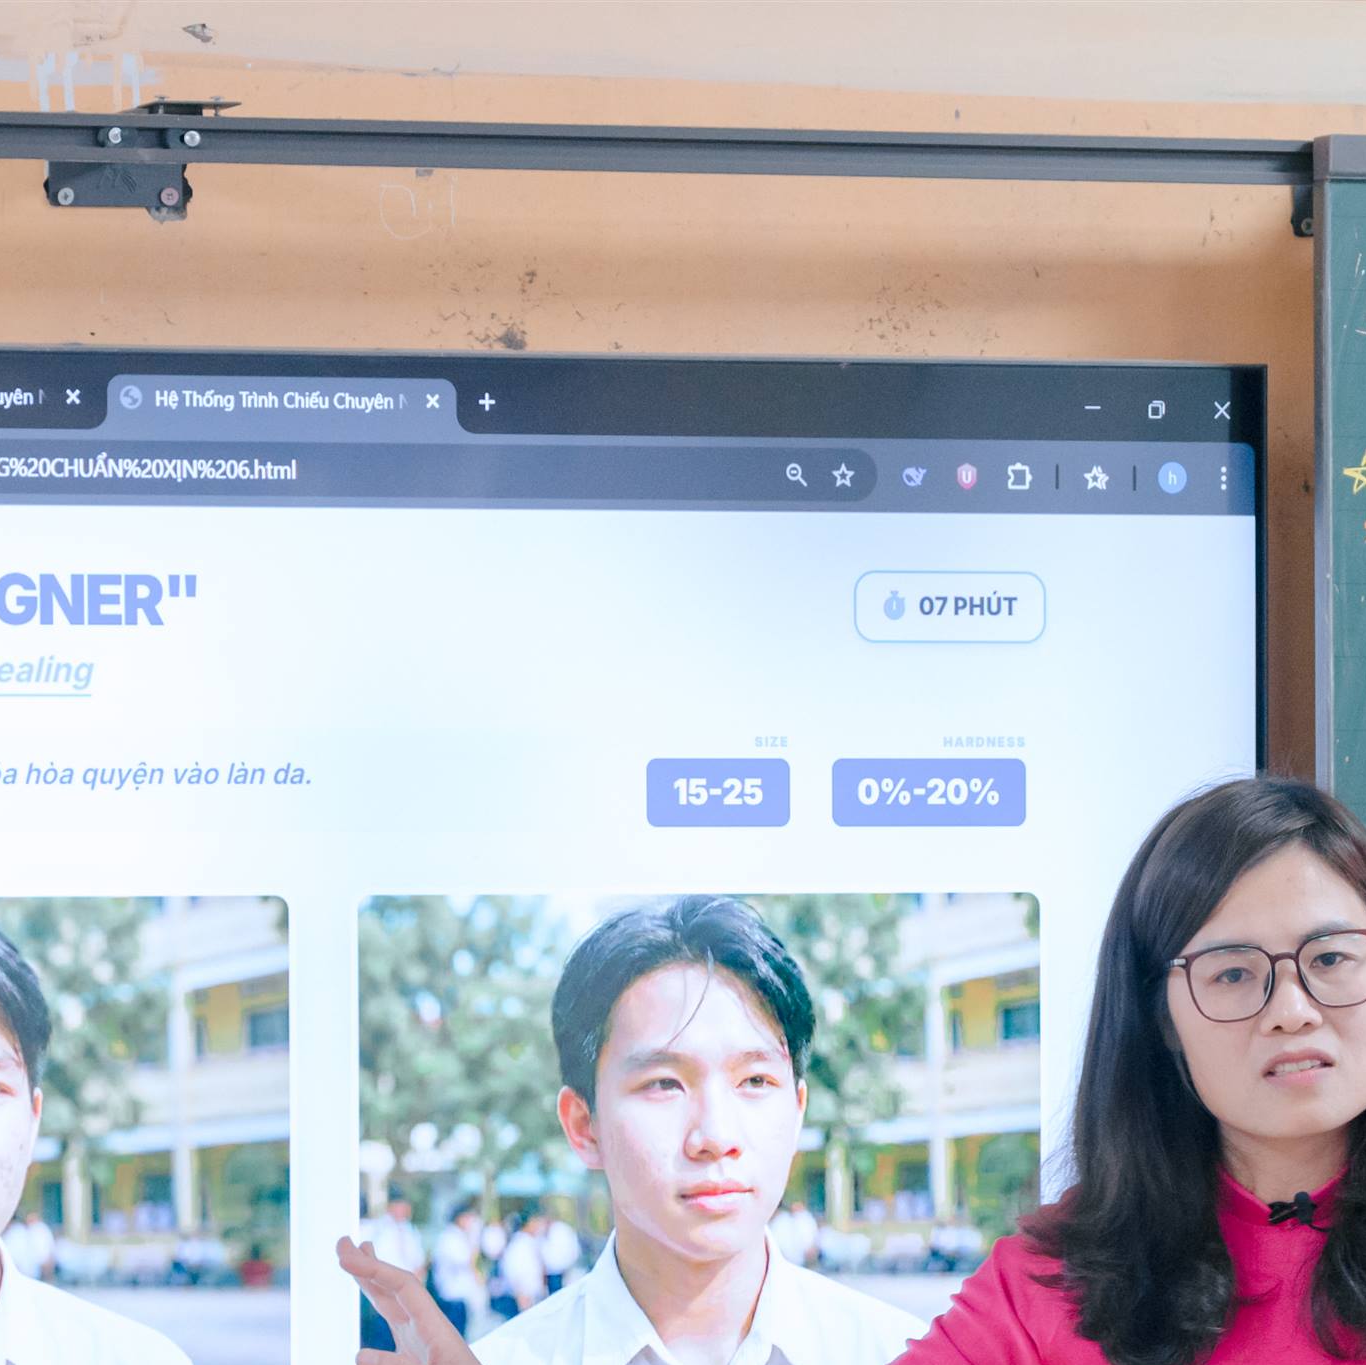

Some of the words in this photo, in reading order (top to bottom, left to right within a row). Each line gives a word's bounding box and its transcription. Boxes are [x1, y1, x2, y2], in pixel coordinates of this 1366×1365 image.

[919, 596, 948, 616] 07
[954, 591, 1018, 616] PHÚT
[754, 736, 788, 748] SIZE
[943, 736, 1026, 748] HARDNESS
[26, 762, 74, 787] hòa
[81, 762, 164, 792] quyện
[172, 762, 219, 787] vào
[226, 762, 266, 787] làn
[273, 762, 312, 787] da.
[674, 777, 763, 806] 15-25
[857, 777, 1000, 806] 0%-20%
